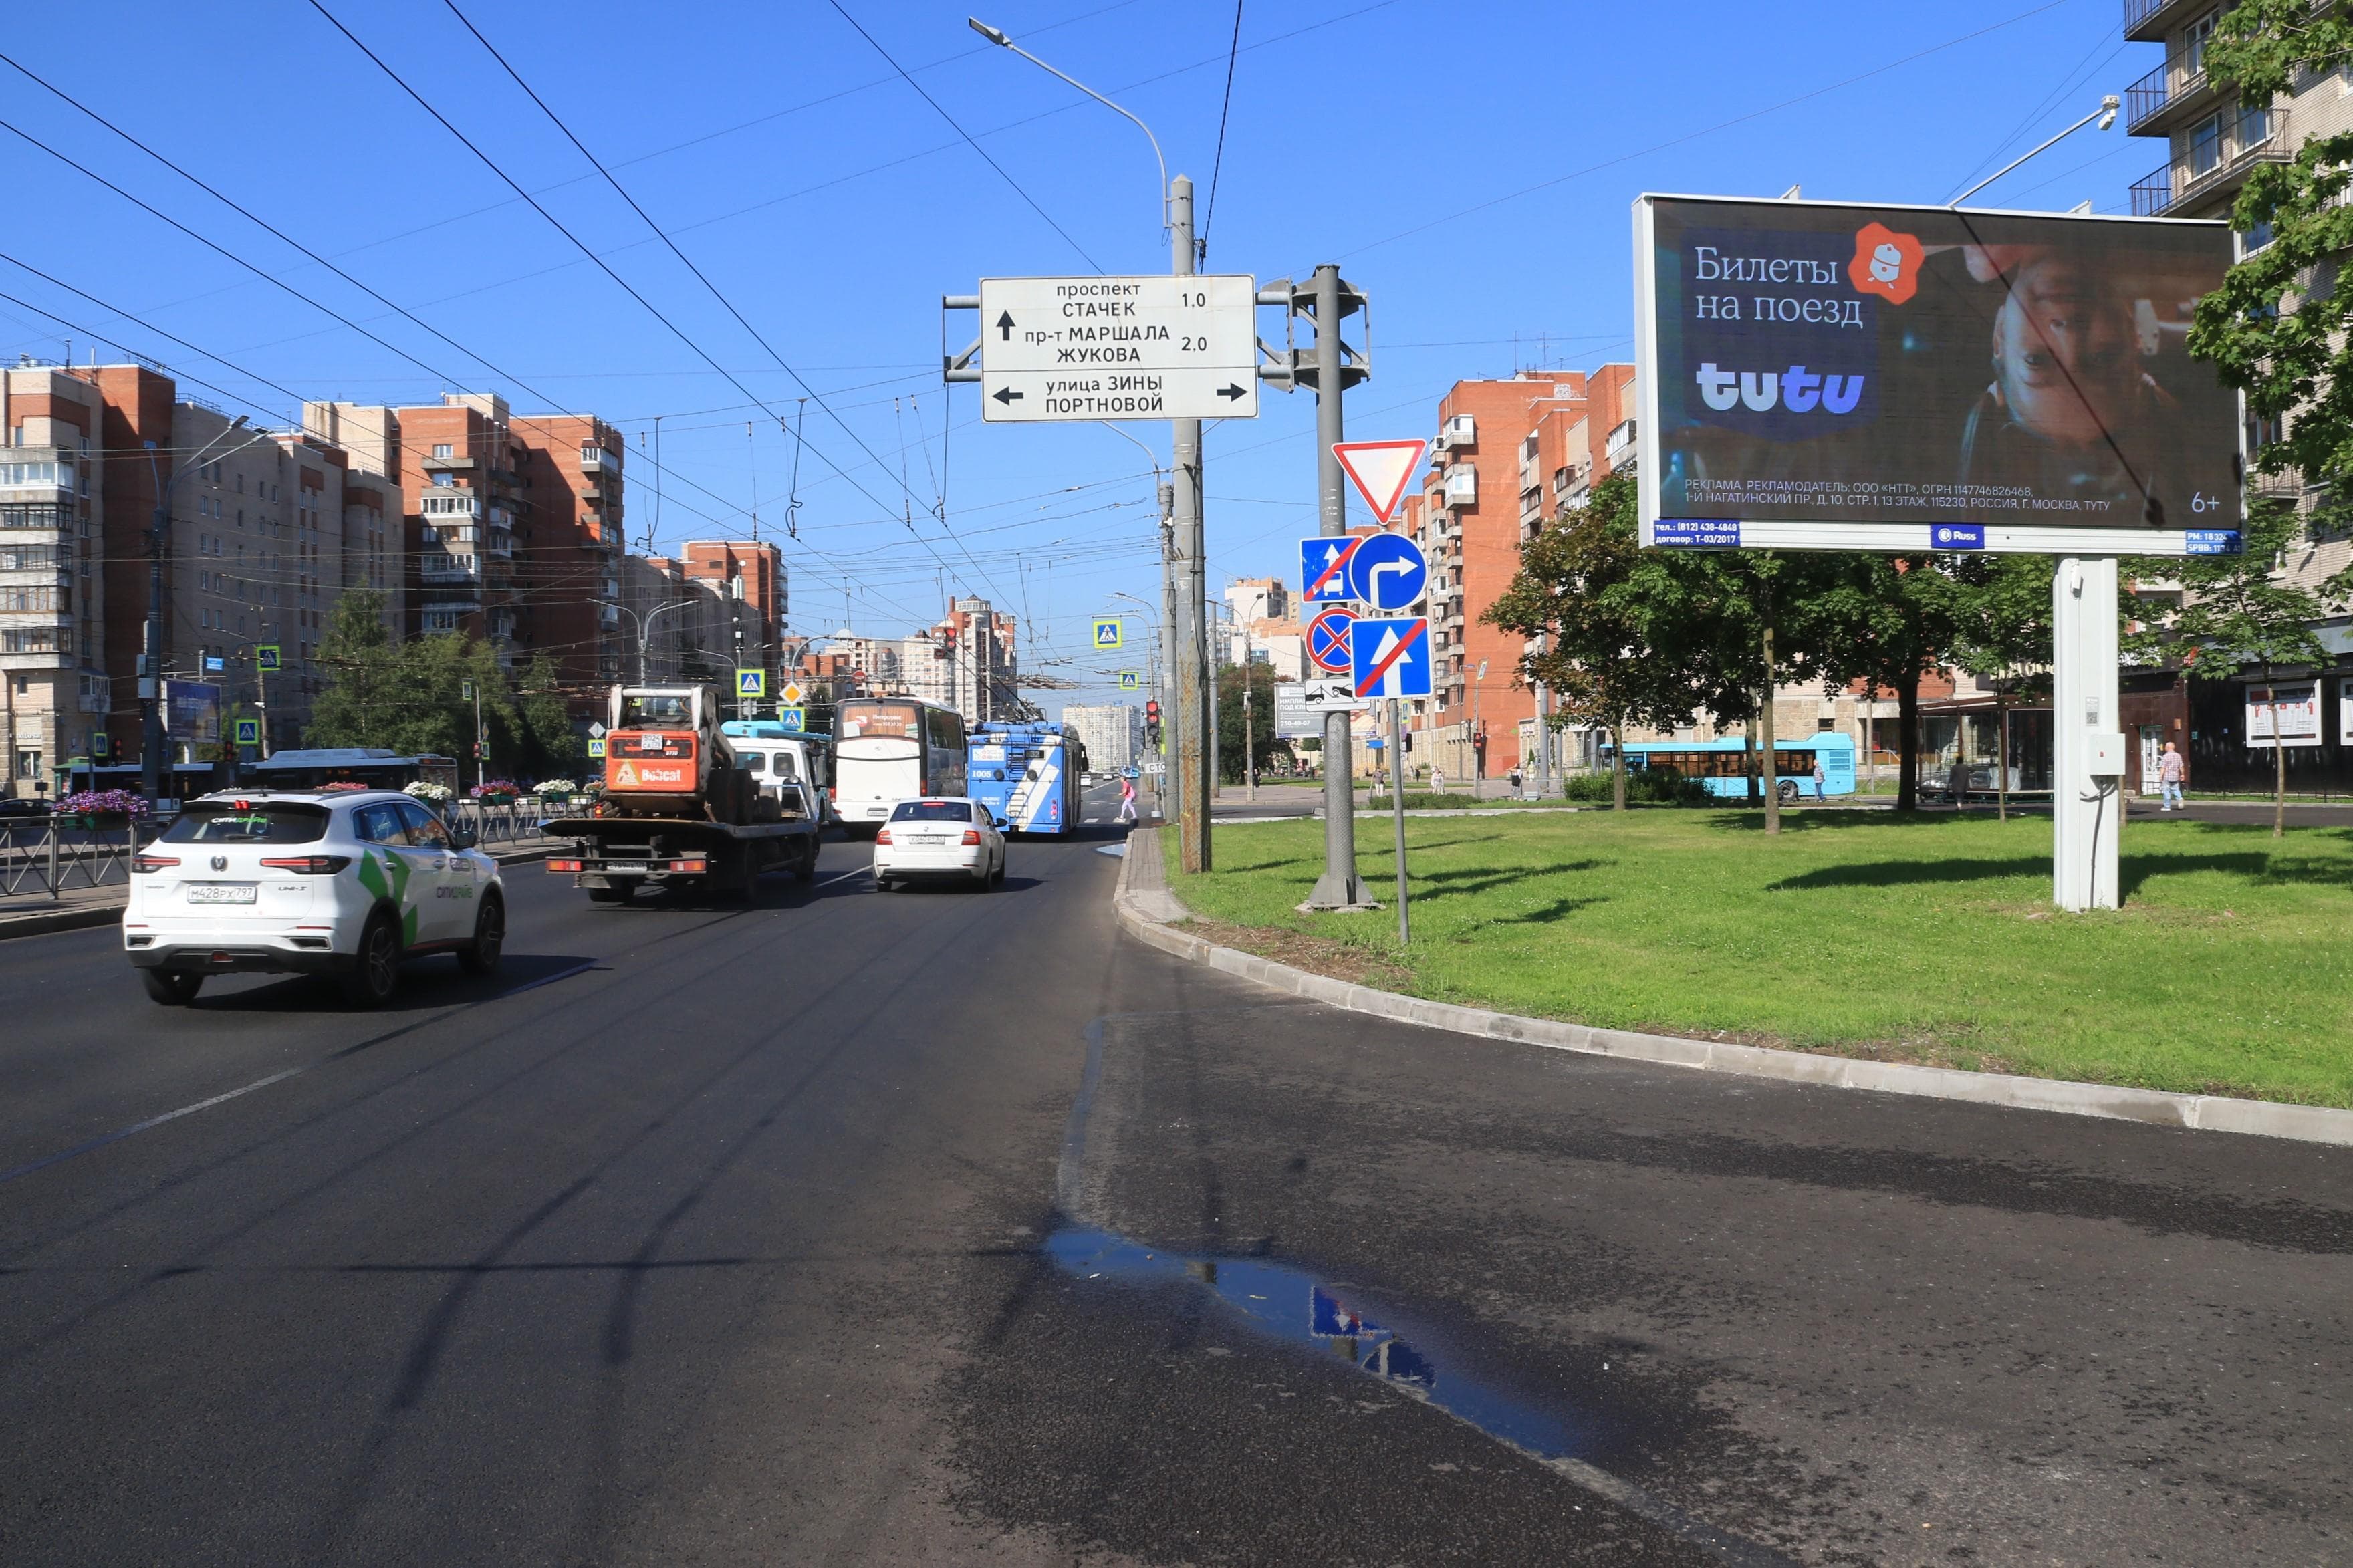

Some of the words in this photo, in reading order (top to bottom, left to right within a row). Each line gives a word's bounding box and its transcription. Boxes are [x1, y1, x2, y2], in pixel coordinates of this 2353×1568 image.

[1695, 246, 1838, 284] Билеты
[1056, 284, 1141, 299] проспект
[1062, 302, 1136, 317] СТАЧЕК
[1695, 295, 1741, 321] на
[1754, 297, 1864, 330] поезд
[1025, 330, 1062, 346] пр-т
[1068, 325, 1170, 342] МАРШАЛА
[1057, 346, 1141, 364] ЖУКОВА
[1046, 380, 1100, 395] улица
[1108, 376, 1163, 392] ЗИНЫ
[1695, 362, 1865, 414] tutu
[1045, 393, 1164, 413] ПОРТНОВОЙ
[1685, 479, 1744, 491] РЕКЛАМА.
[1747, 481, 1850, 493] РЕКЛАМОДАТЕЛЬ:
[1853, 483, 1879, 493] ООО
[1921, 485, 1951, 495] ОГРН
[1685, 489, 1703, 502] 1-Й
[1705, 491, 1792, 504] НАГАТИНСКИЙ
[1883, 496, 1893, 506] 13
[2084, 500, 2110, 511] ТУТУ
[2191, 491, 2221, 513] 6+
[1677, 522, 1699, 532] (812)
[1699, 523, 1738, 532] 438-4848
[1953, 531, 1977, 541] Russ
[1655, 535, 1694, 545] договор:
[972, 770, 991, 778] 1005
[1149, 763, 1166, 771] СТО
